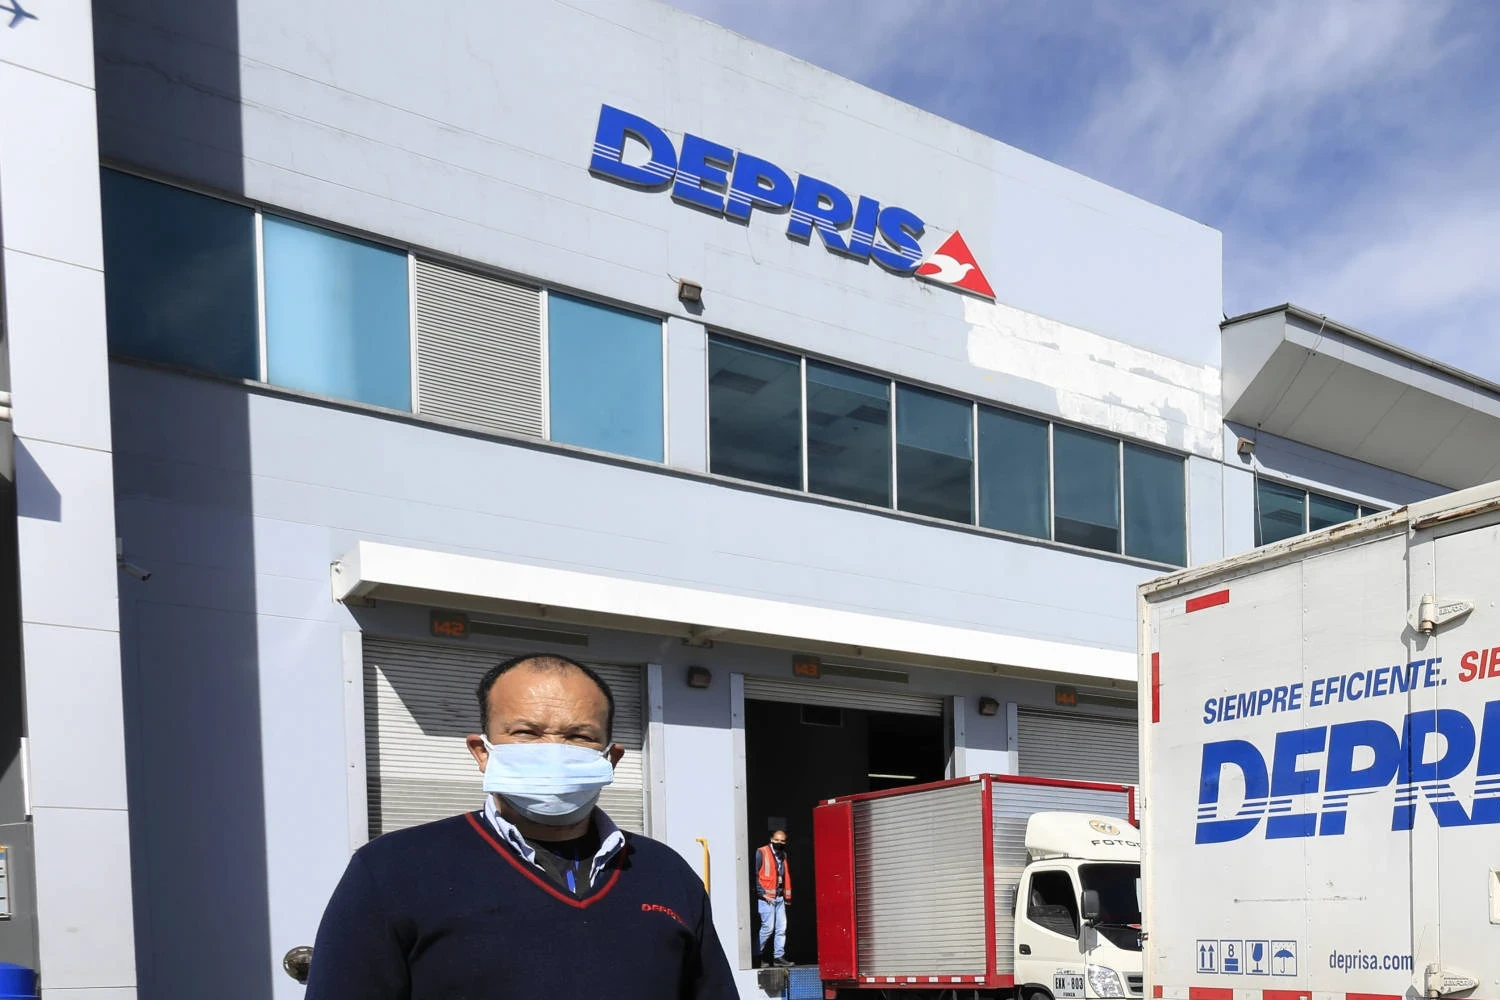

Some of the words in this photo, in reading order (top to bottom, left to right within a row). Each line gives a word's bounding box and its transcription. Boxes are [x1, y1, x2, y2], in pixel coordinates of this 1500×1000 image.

[433, 619, 465, 637] 142
[1203, 682, 1303, 725] SIEMPRE
[1309, 657, 1447, 708] EFICIENTE.
[1329, 949, 1413, 974] deprisa.com
